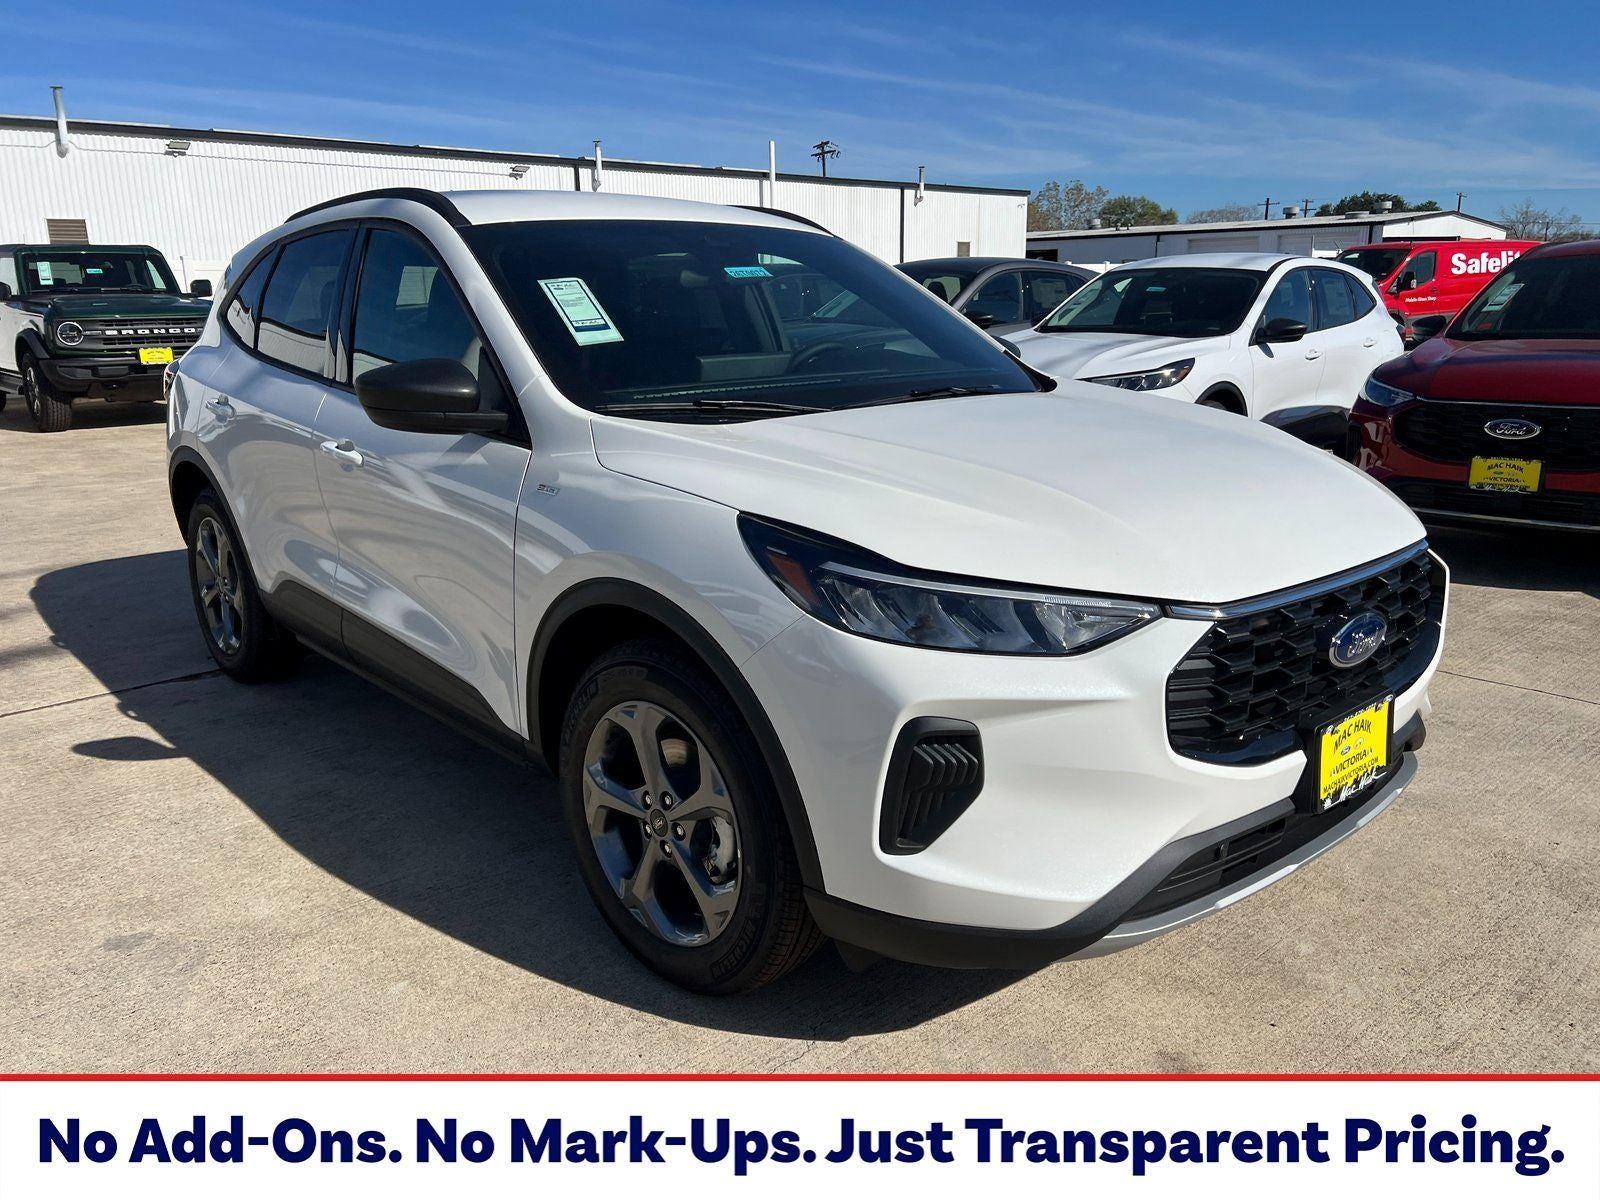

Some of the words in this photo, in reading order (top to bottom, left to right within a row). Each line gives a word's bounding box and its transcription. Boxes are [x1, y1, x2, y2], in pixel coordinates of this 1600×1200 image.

[105, 327, 196, 335] BRONCO
[1496, 422, 1527, 435] Ford
[1333, 723, 1353, 752] MAC
[1354, 718, 1373, 735] HAIK
[1335, 749, 1367, 774] VICTORIA
